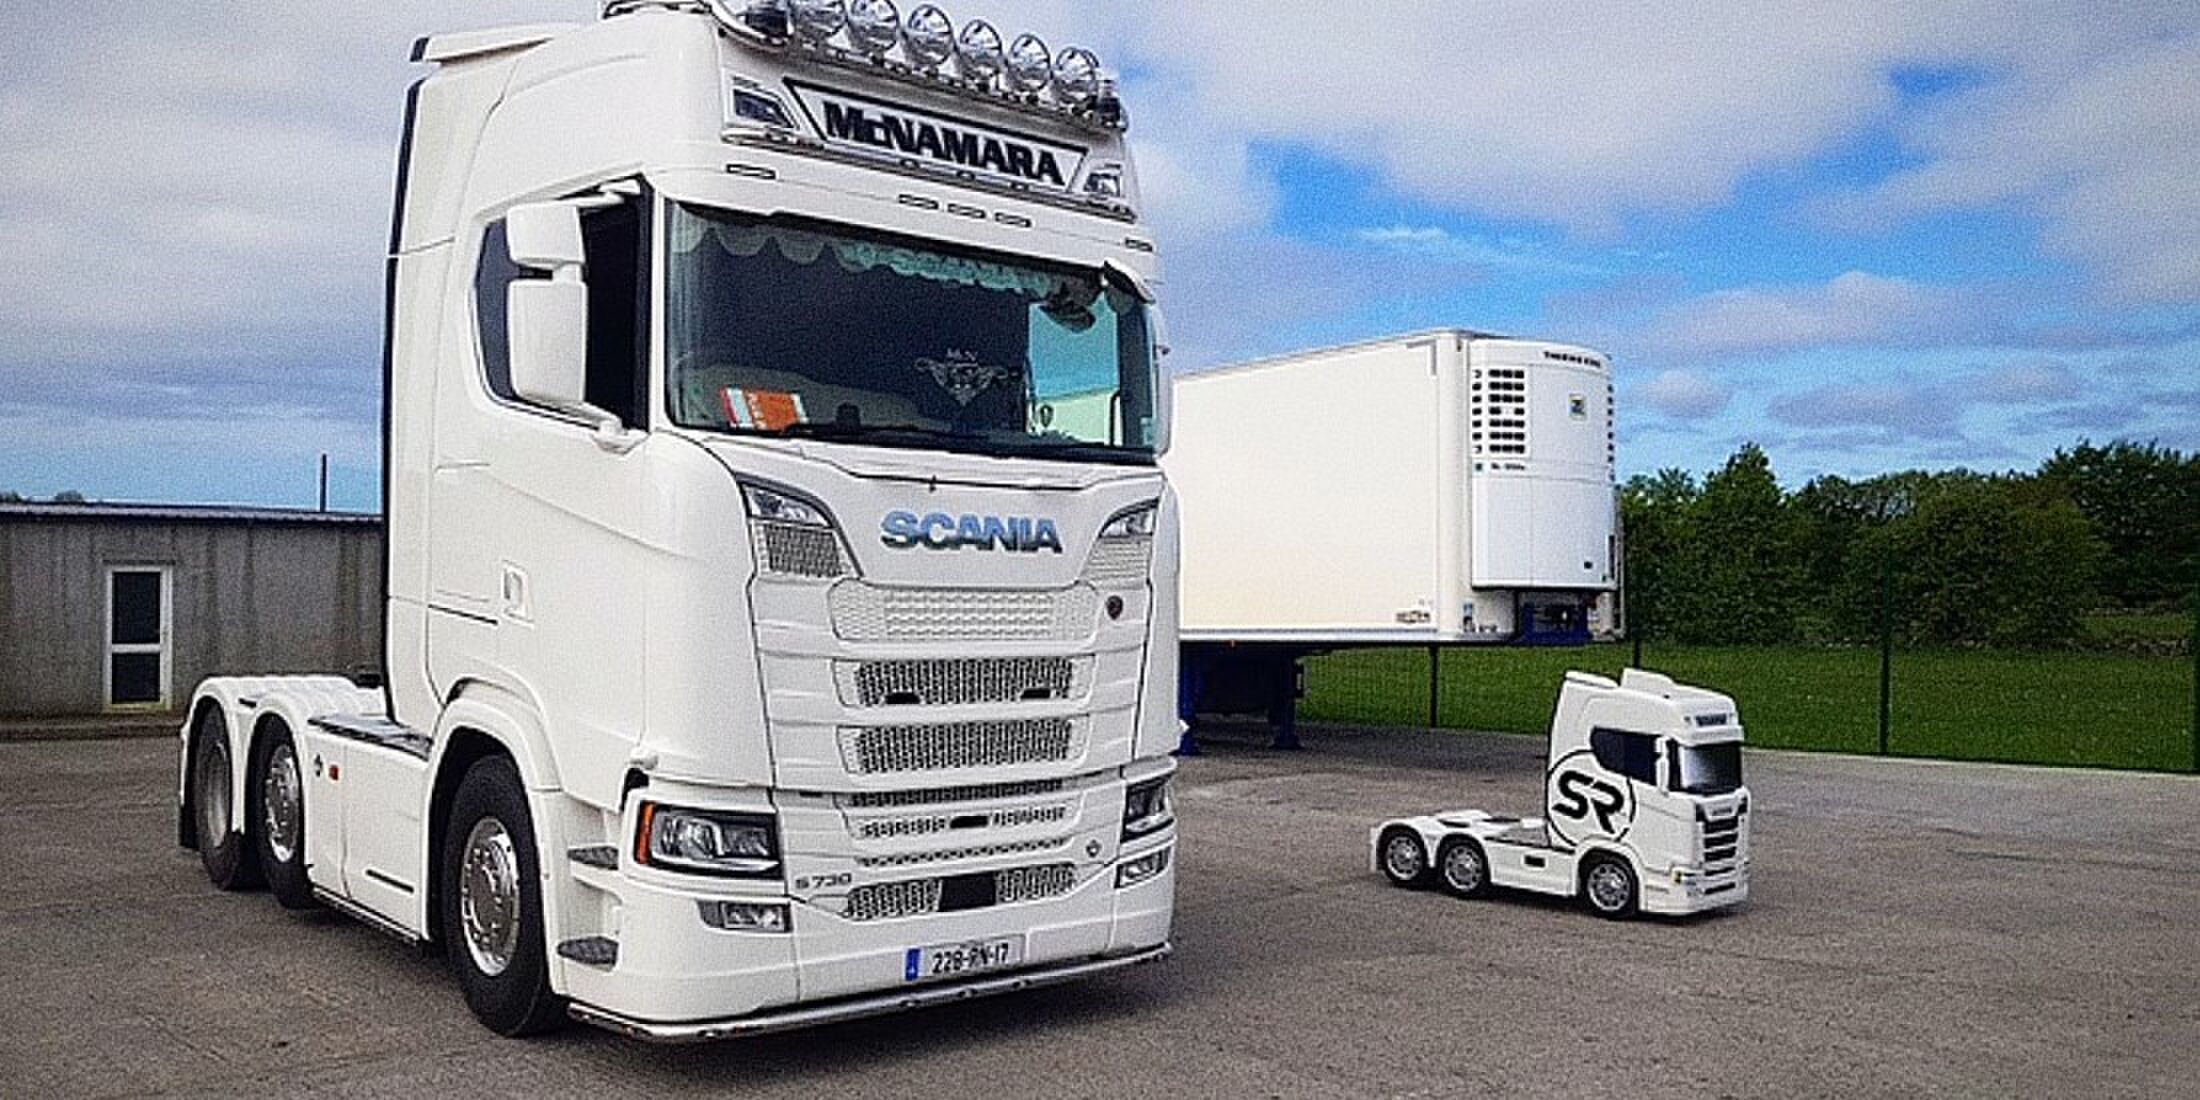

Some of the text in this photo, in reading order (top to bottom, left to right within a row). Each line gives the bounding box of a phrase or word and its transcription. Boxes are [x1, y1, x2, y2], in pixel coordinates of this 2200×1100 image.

[822, 100, 1065, 187] McNAMARA
[881, 510, 1063, 553] SCANIA
[1552, 770, 1624, 834] SR
